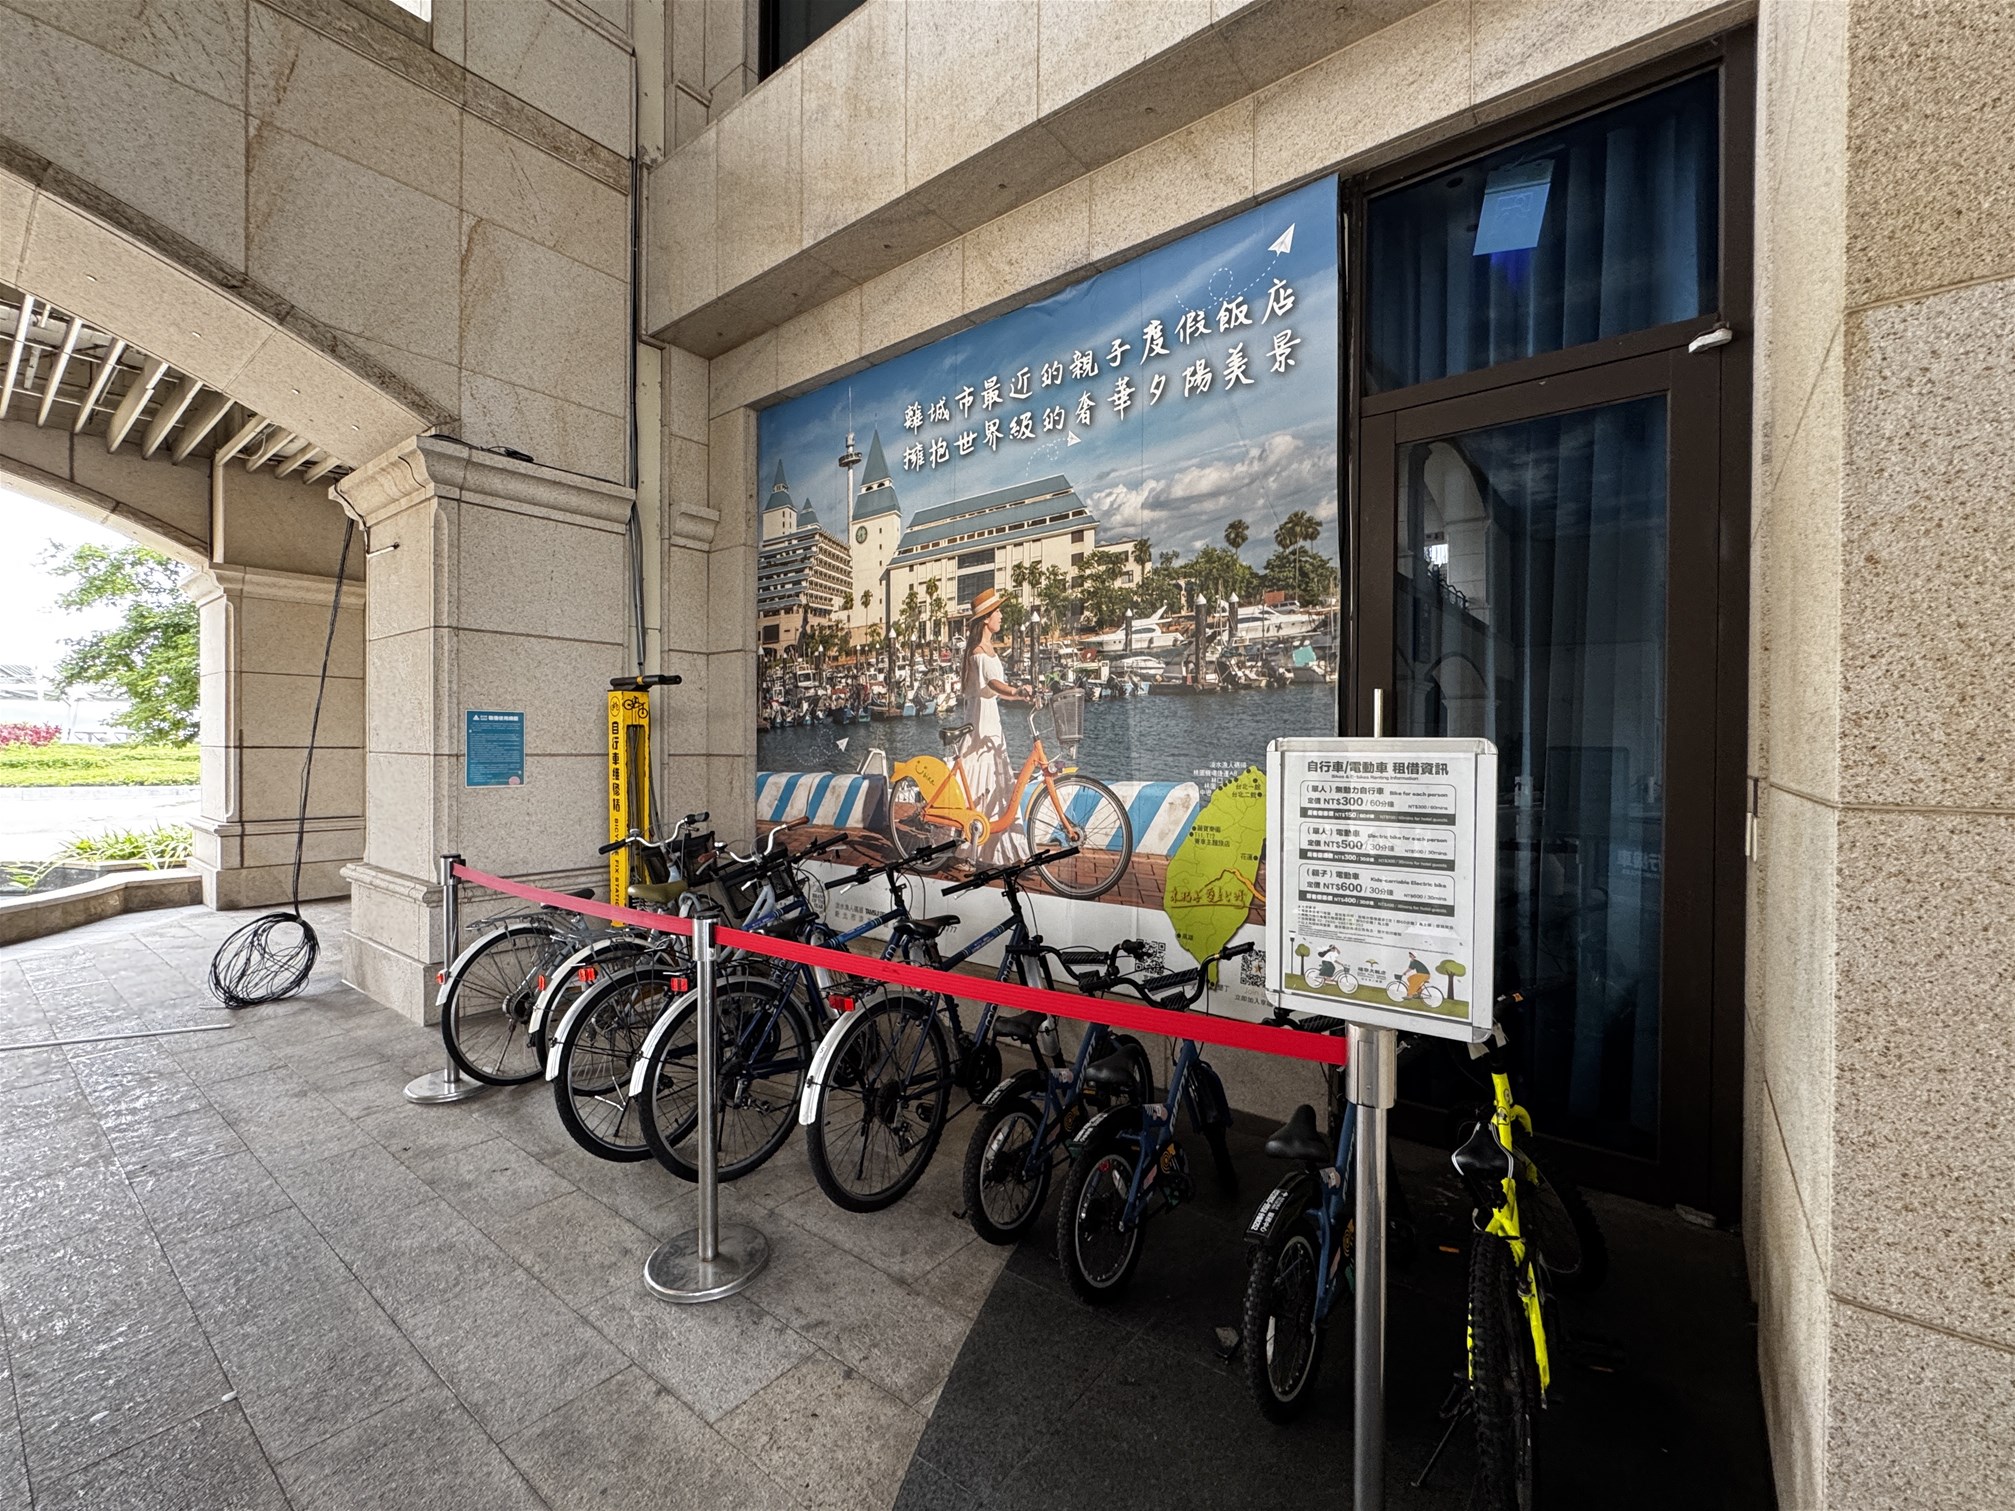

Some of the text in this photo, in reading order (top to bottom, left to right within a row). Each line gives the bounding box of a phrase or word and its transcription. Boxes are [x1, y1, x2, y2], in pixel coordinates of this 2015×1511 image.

[903, 278, 1296, 435] 離城市最近的親子度假飯店
[902, 329, 1301, 471] 擁抱世界級的奢華夕陽美景
[1307, 760, 1449, 776] 自行車/電動車 租借資訊
[1323, 796, 1364, 807] NT$300
[1323, 839, 1363, 850] NT$500
[1323, 882, 1363, 893] NT$600
